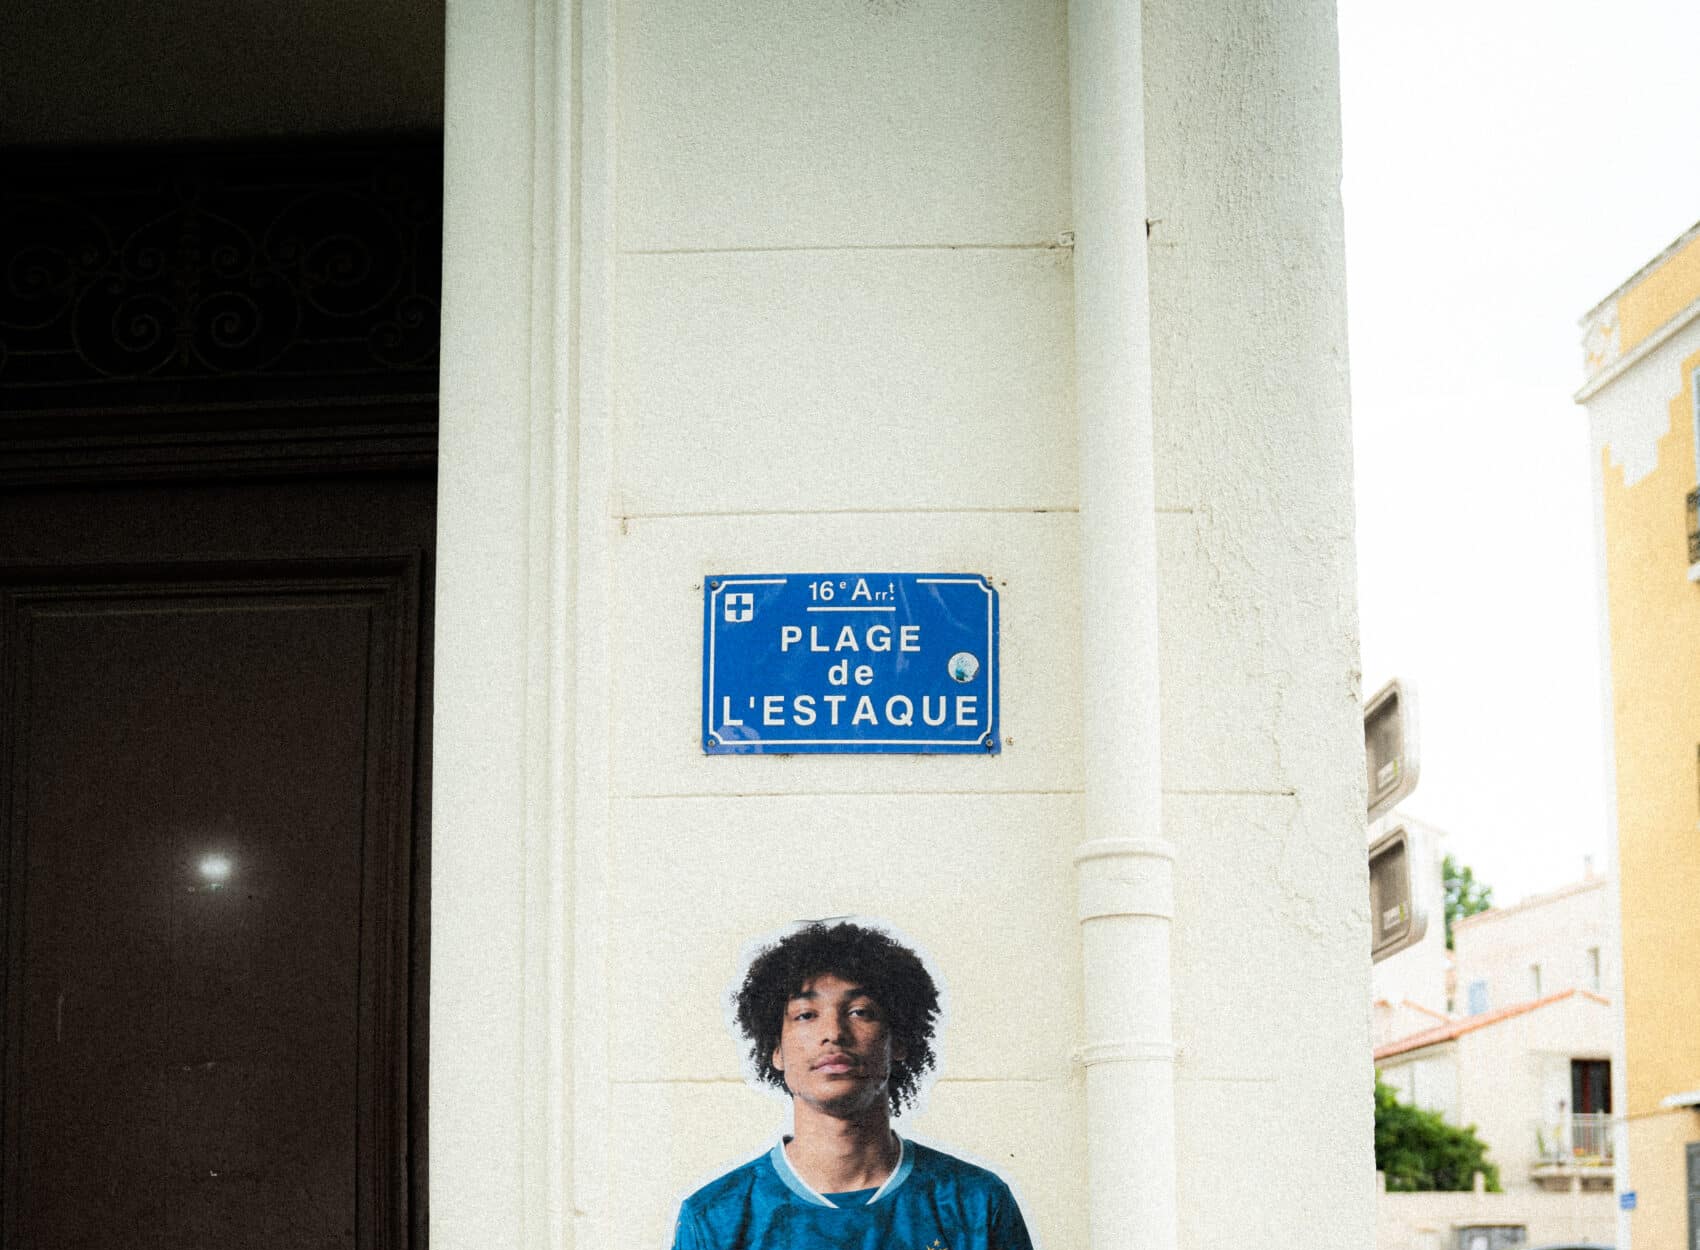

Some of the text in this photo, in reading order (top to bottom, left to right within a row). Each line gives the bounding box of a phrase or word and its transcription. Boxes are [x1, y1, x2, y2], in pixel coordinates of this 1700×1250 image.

[781, 625, 921, 652] PLAGE
[828, 659, 874, 686] de
[723, 695, 978, 726] L'ESTAQUE
